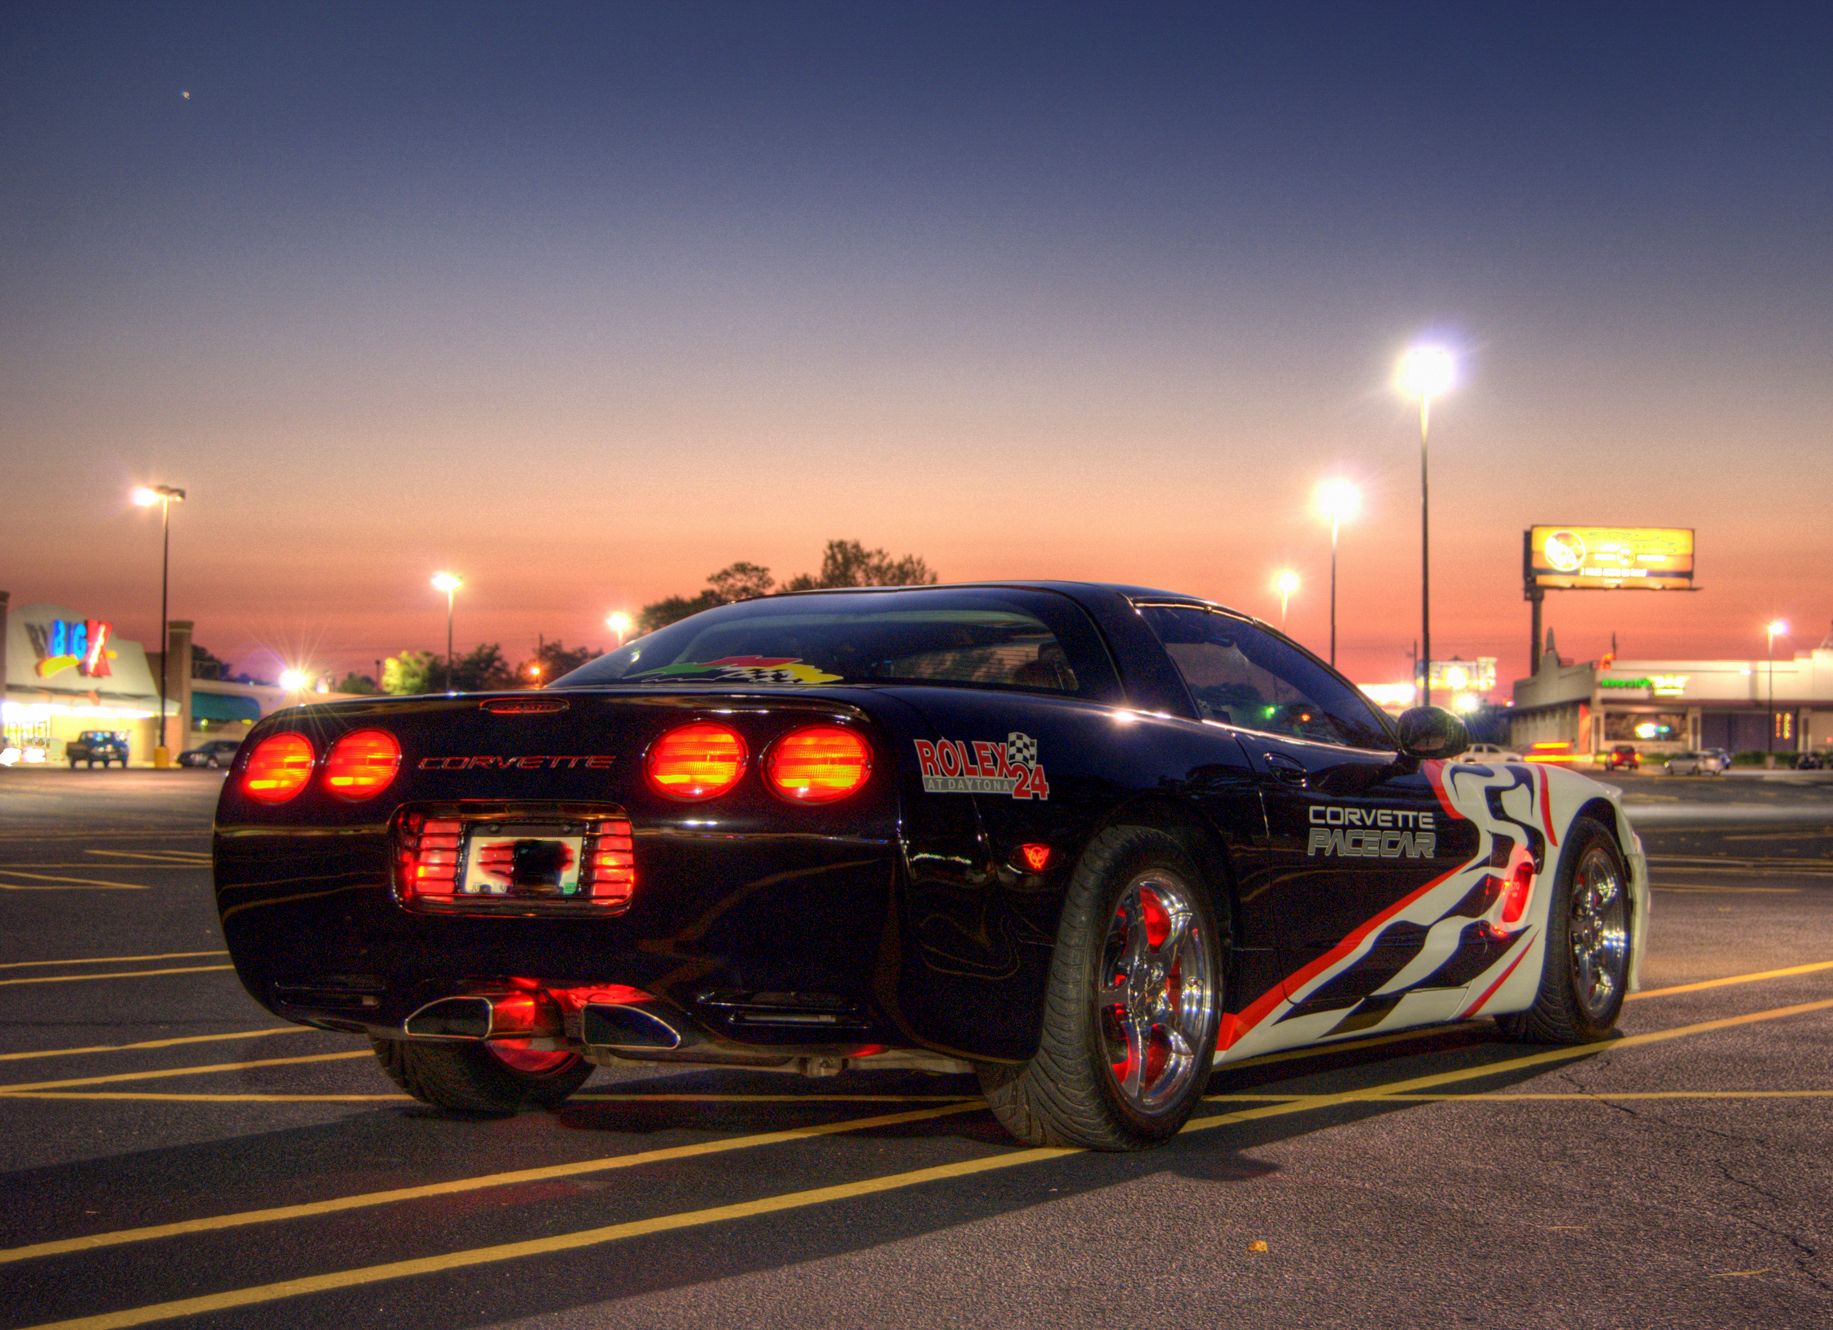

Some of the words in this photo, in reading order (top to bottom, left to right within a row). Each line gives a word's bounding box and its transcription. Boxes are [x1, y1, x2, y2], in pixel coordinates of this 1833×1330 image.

[51, 618, 87, 660] BIG
[418, 755, 617, 770] CORVETTE
[913, 739, 1016, 778] ROLEX
[1012, 762, 1050, 800] 24
[928, 778, 944, 790] AT
[948, 778, 1011, 791] DAYTONA
[1309, 806, 1436, 829] CORVETTE
[1307, 827, 1437, 858] PACECAR
